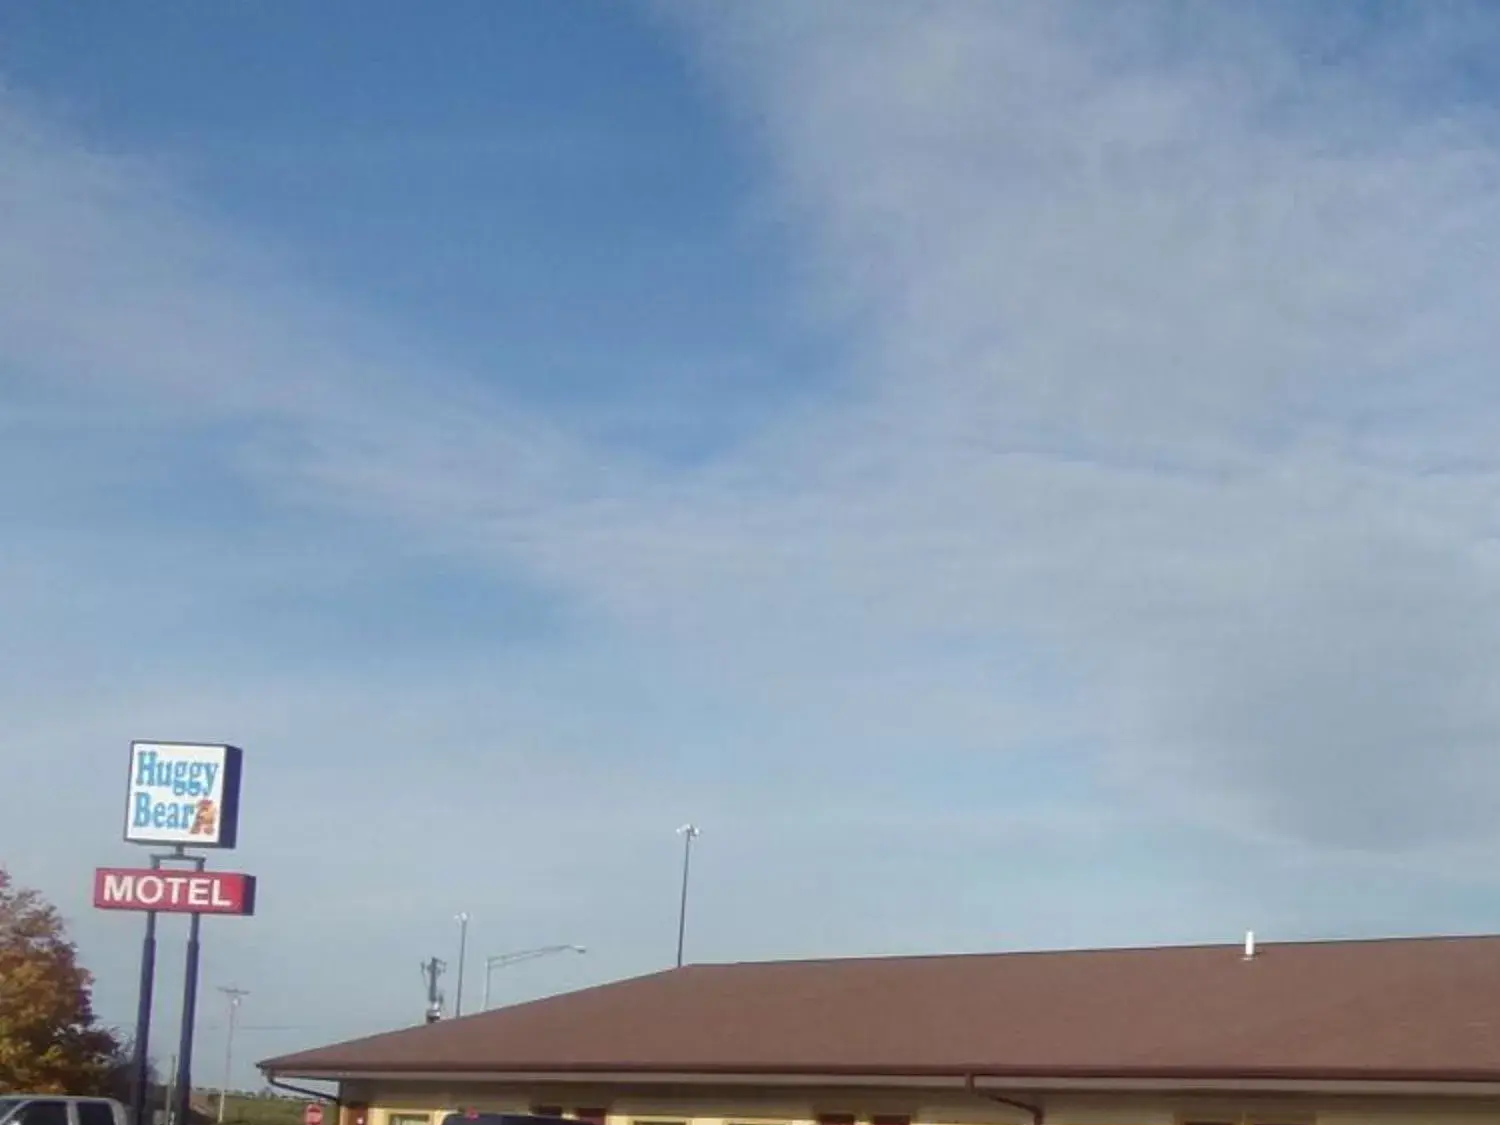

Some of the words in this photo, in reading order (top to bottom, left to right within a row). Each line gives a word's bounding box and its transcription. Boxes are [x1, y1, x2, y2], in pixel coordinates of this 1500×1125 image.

[135, 750, 219, 796] Huggy
[132, 791, 195, 829] Bear
[102, 874, 233, 906] MOTEL
